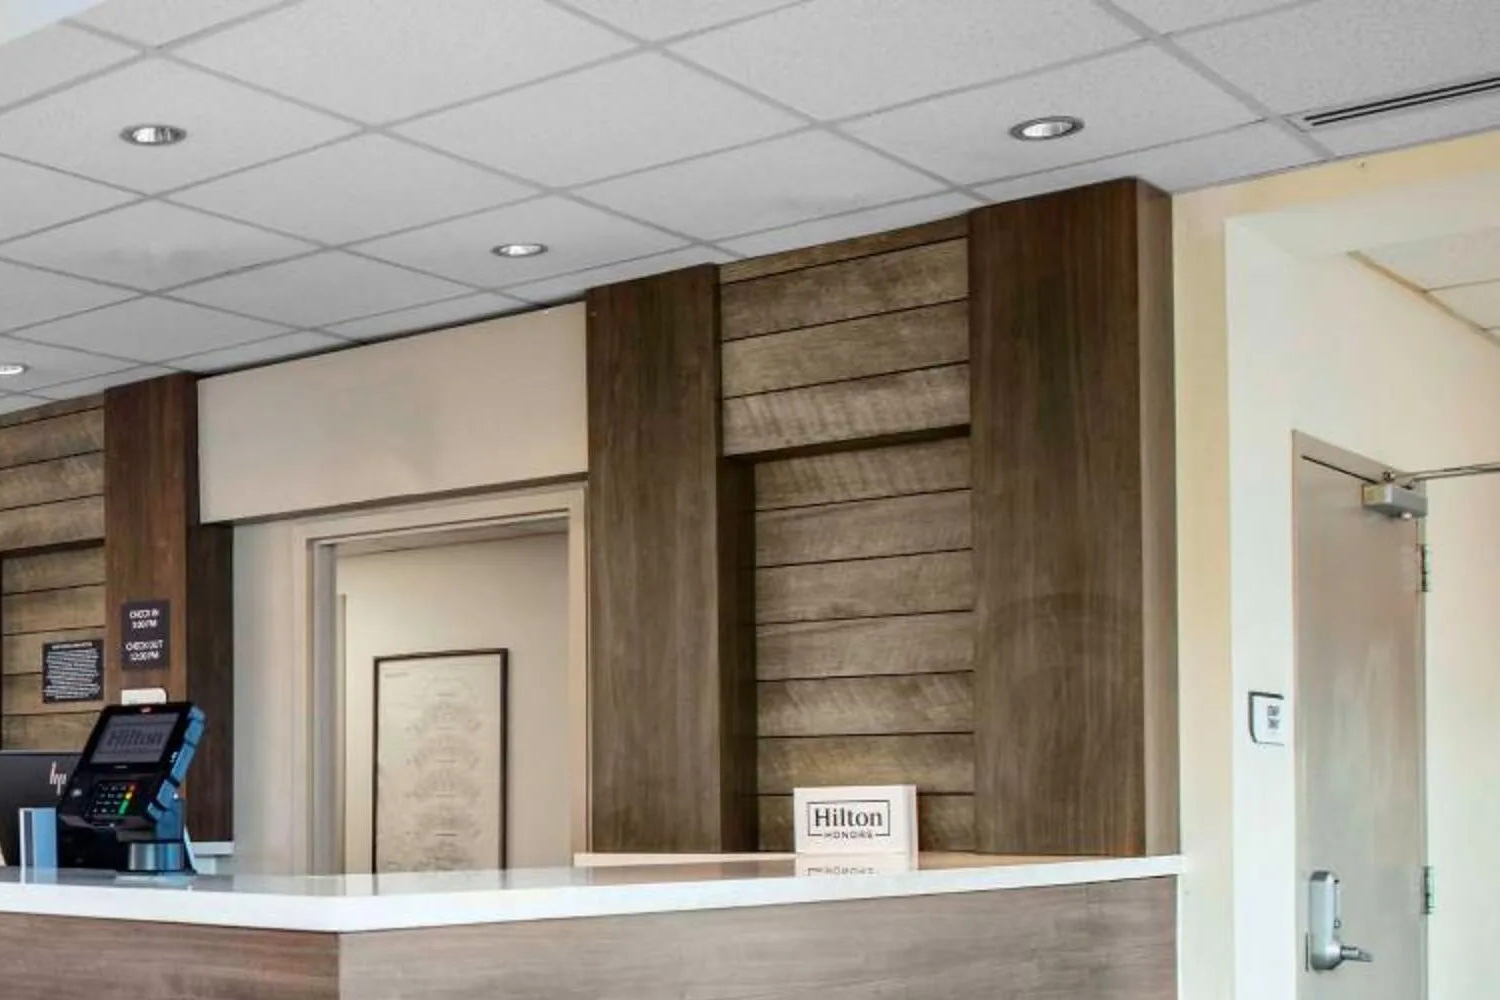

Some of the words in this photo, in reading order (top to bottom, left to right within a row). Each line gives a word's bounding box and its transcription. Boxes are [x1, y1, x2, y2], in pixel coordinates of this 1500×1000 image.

[129, 609, 151, 620] CHECK
[151, 608, 160, 618] IN
[107, 728, 164, 747] Hilton
[49, 761, 67, 796] hp
[814, 807, 883, 828] Hilton
[823, 830, 874, 839] HONORS
